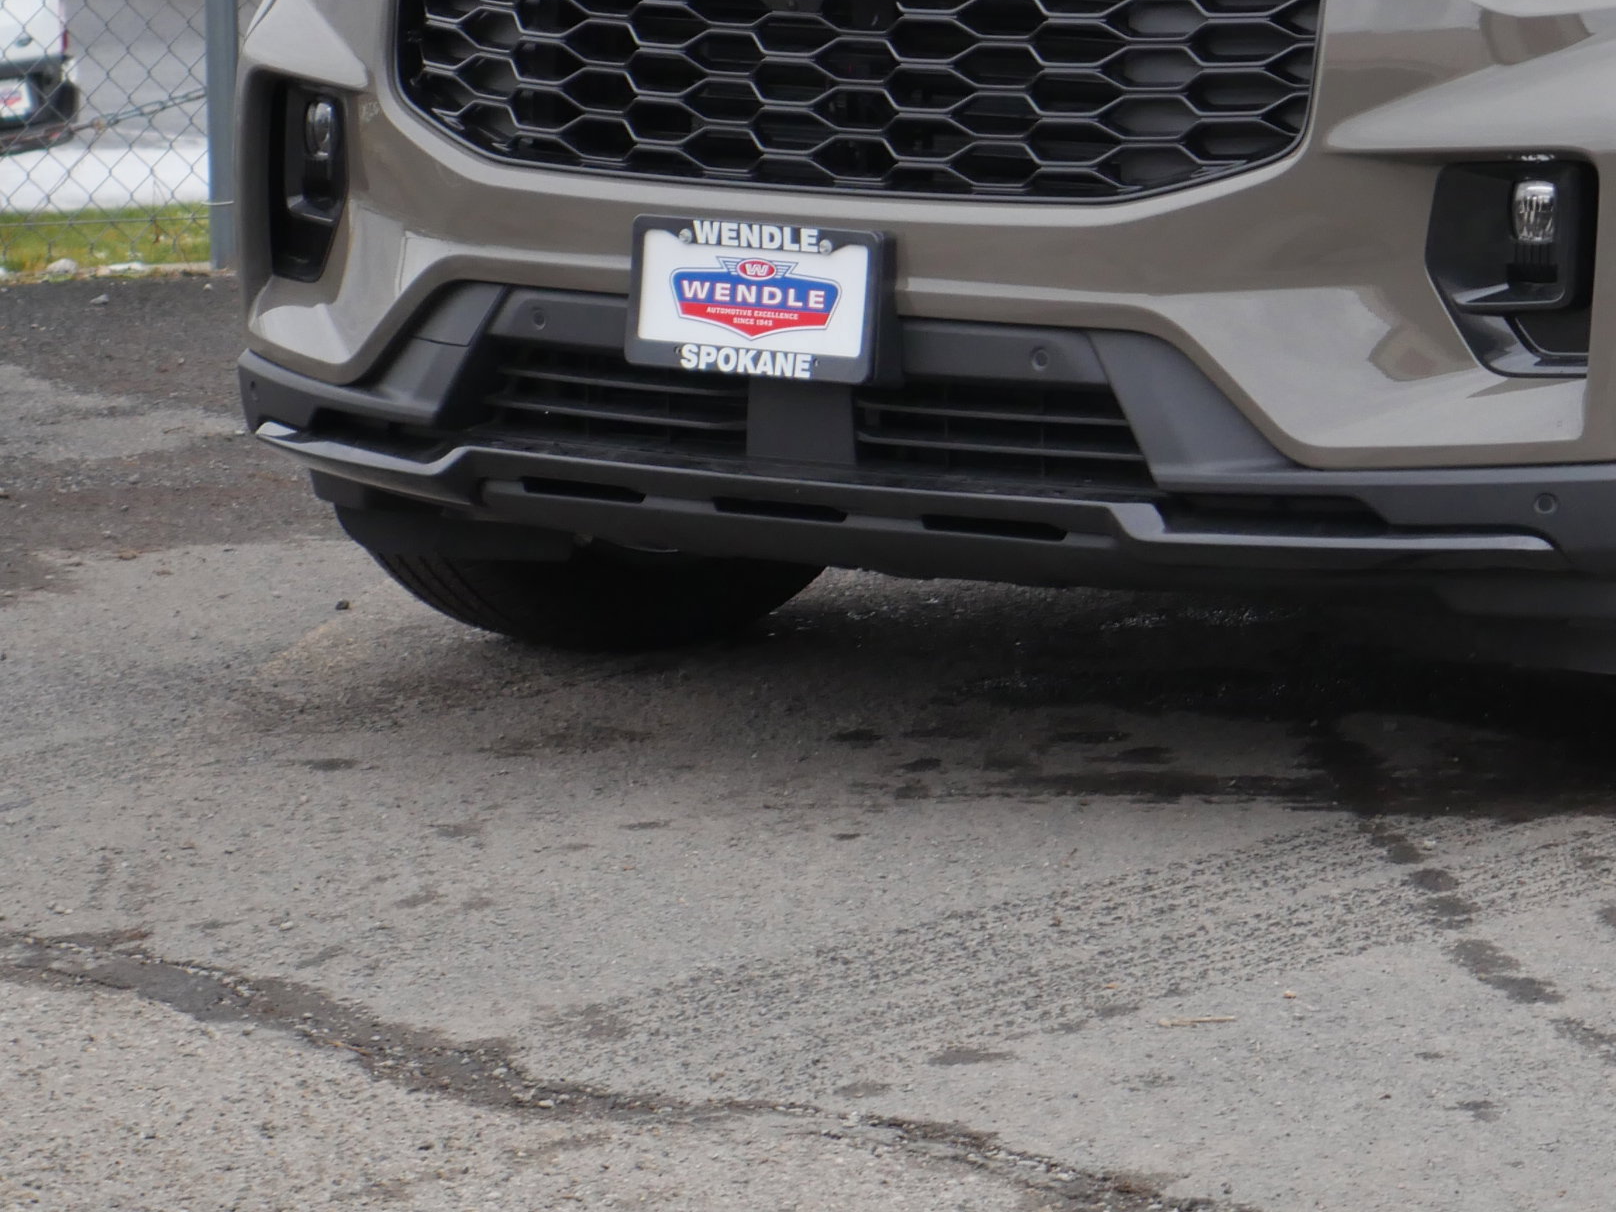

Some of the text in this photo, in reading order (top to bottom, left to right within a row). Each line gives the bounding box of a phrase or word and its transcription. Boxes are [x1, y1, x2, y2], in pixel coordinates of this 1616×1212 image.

[693, 219, 820, 253] WENDLE
[682, 279, 825, 309] WENDLE
[706, 305, 799, 321] AUTOMOTIVE EXCELLENCE
[733, 316, 755, 326] SINCE
[680, 343, 813, 379] SPOKANE
